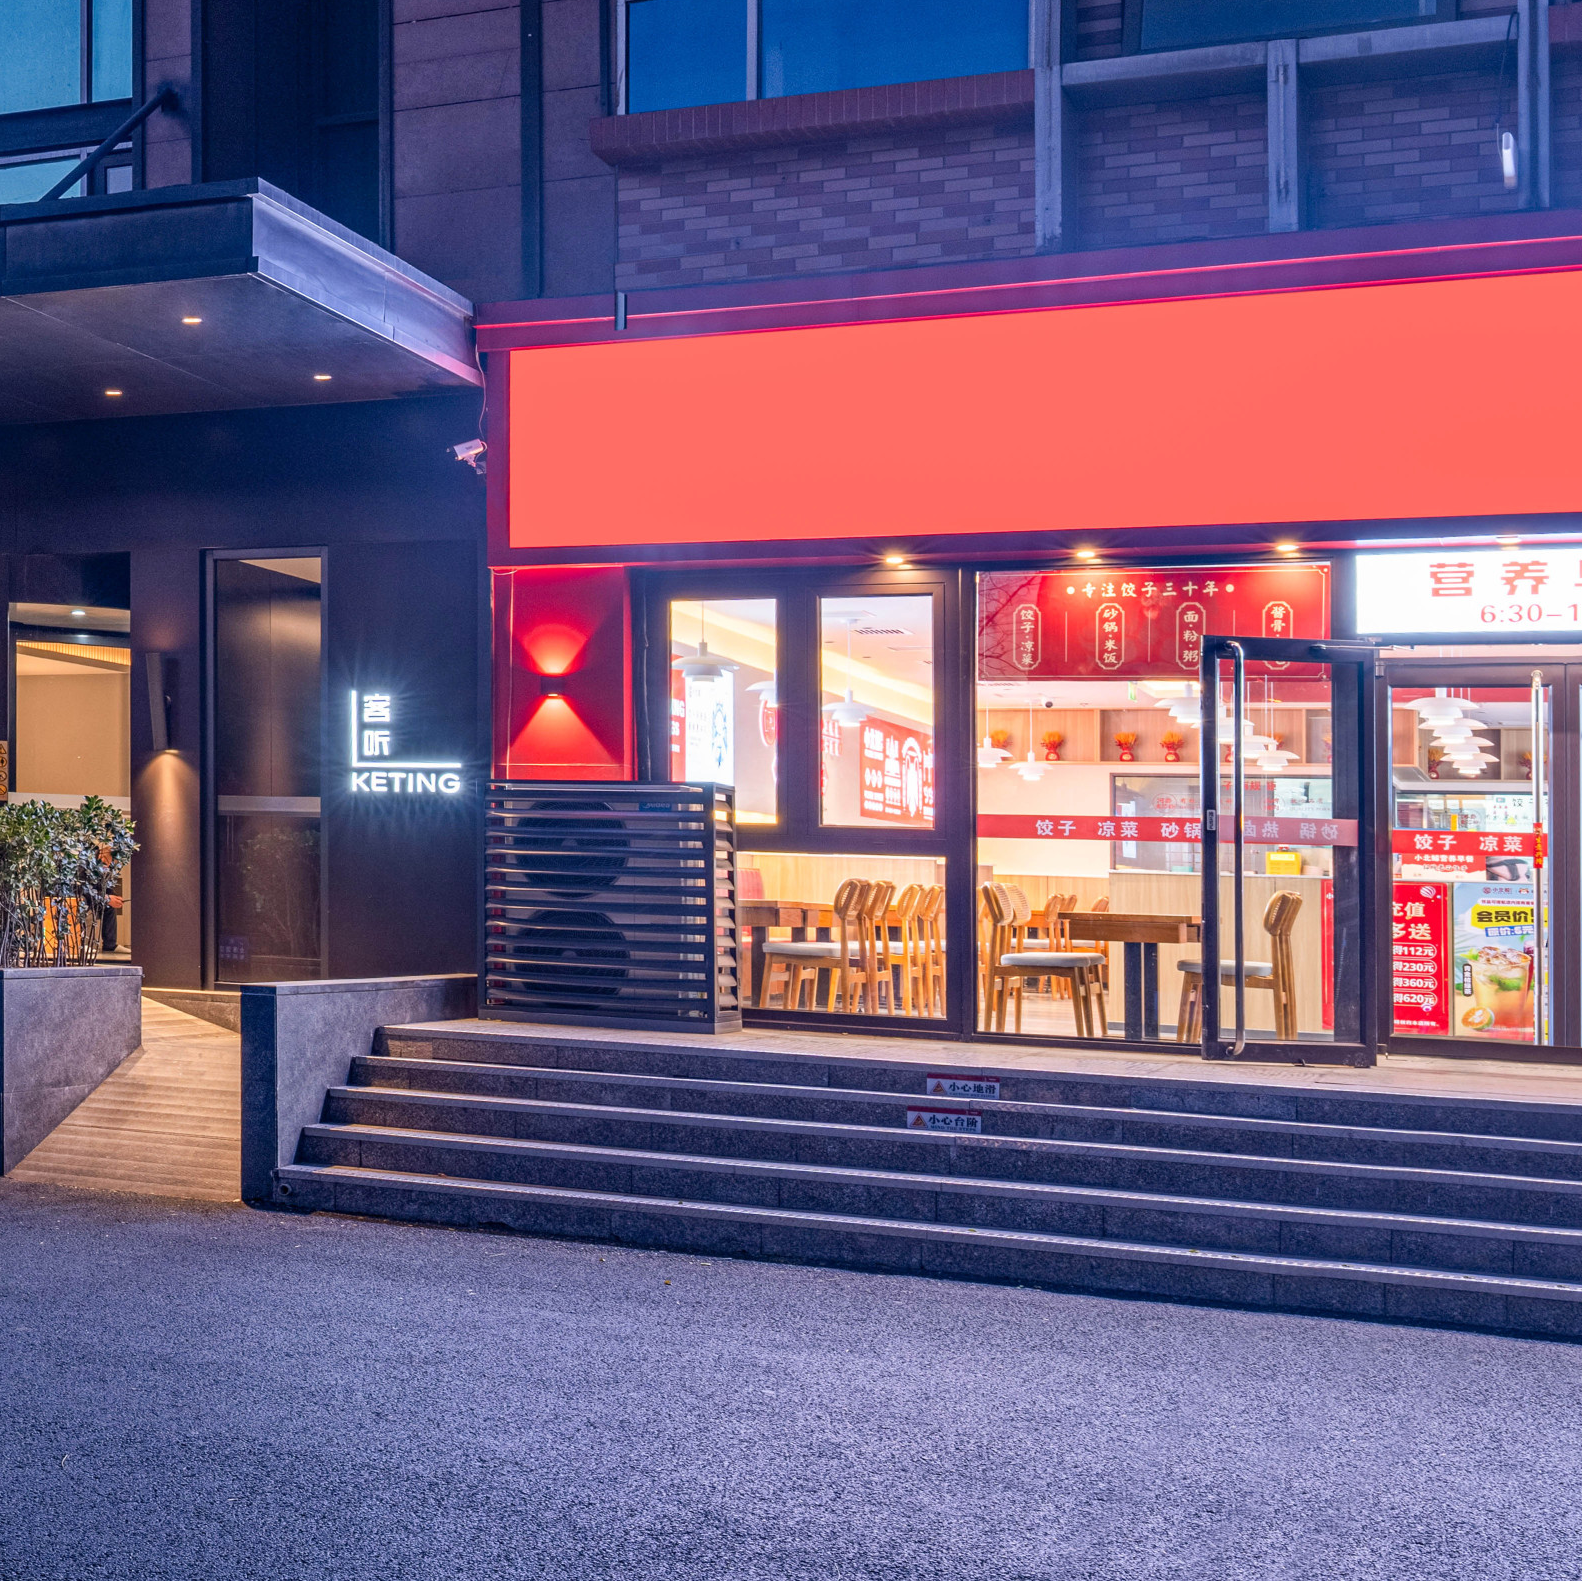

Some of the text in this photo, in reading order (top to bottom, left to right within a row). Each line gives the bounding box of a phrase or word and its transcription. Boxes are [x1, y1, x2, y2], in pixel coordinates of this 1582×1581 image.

[1429, 560, 1582, 597] 营养
[1082, 581, 1219, 598] 专注饺子三十年
[351, 771, 461, 793] KETING
[1036, 820, 1201, 838] 饺子 凉菜 砂锅
[1414, 834, 1523, 852] 饺子 凉菜
[1477, 909, 1534, 923] 会员价
[949, 1082, 996, 1094] 小心地滑
[929, 1114, 978, 1127] 小心台阶
